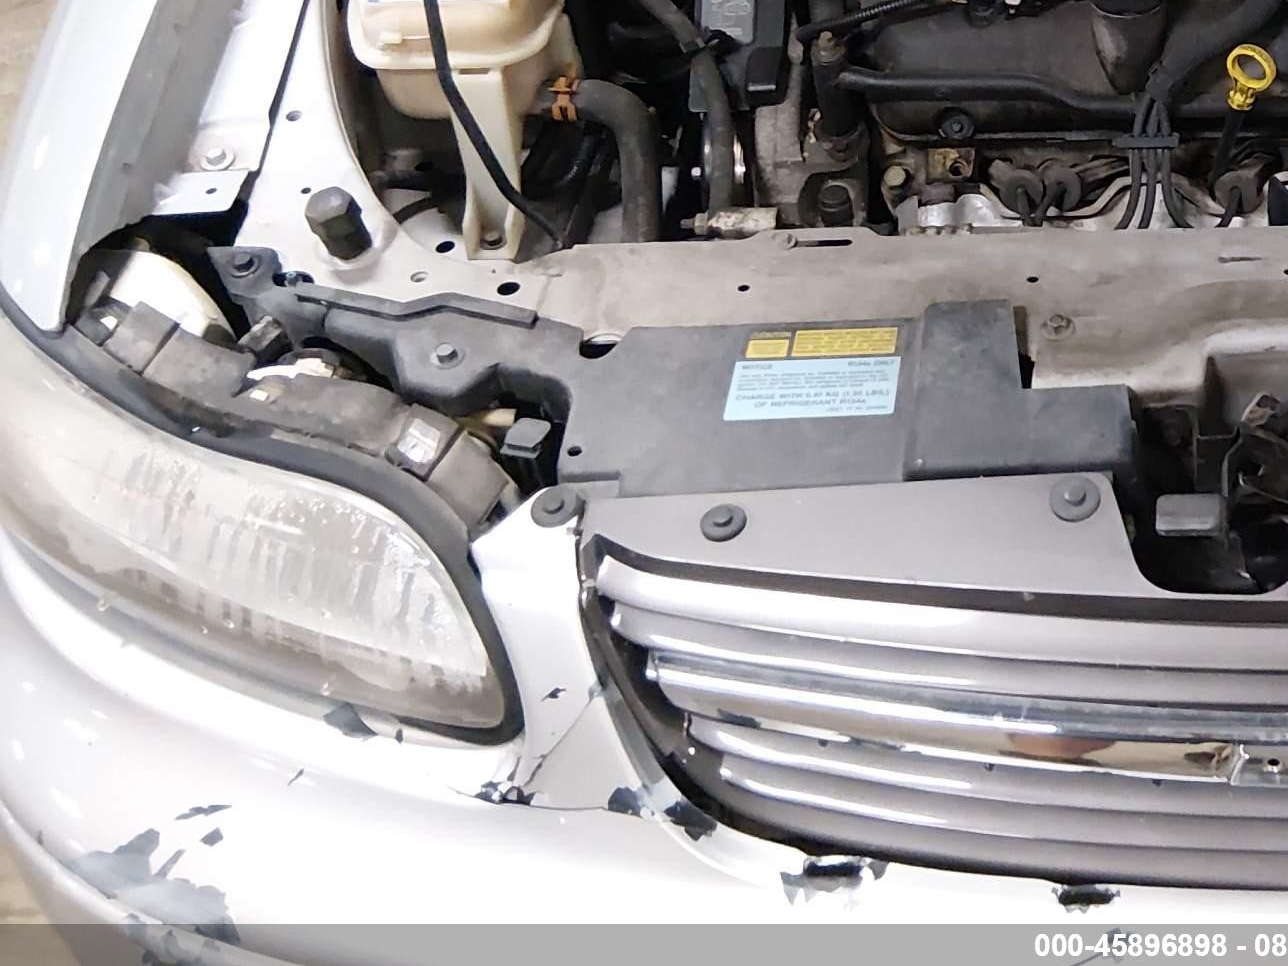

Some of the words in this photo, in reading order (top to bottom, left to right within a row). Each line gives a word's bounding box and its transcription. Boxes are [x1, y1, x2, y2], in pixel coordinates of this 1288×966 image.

[742, 363, 773, 371] NOTICE
[735, 393, 775, 401] CHARGE
[779, 392, 804, 400] WITH
[770, 398, 837, 408] REFRIGERANT
